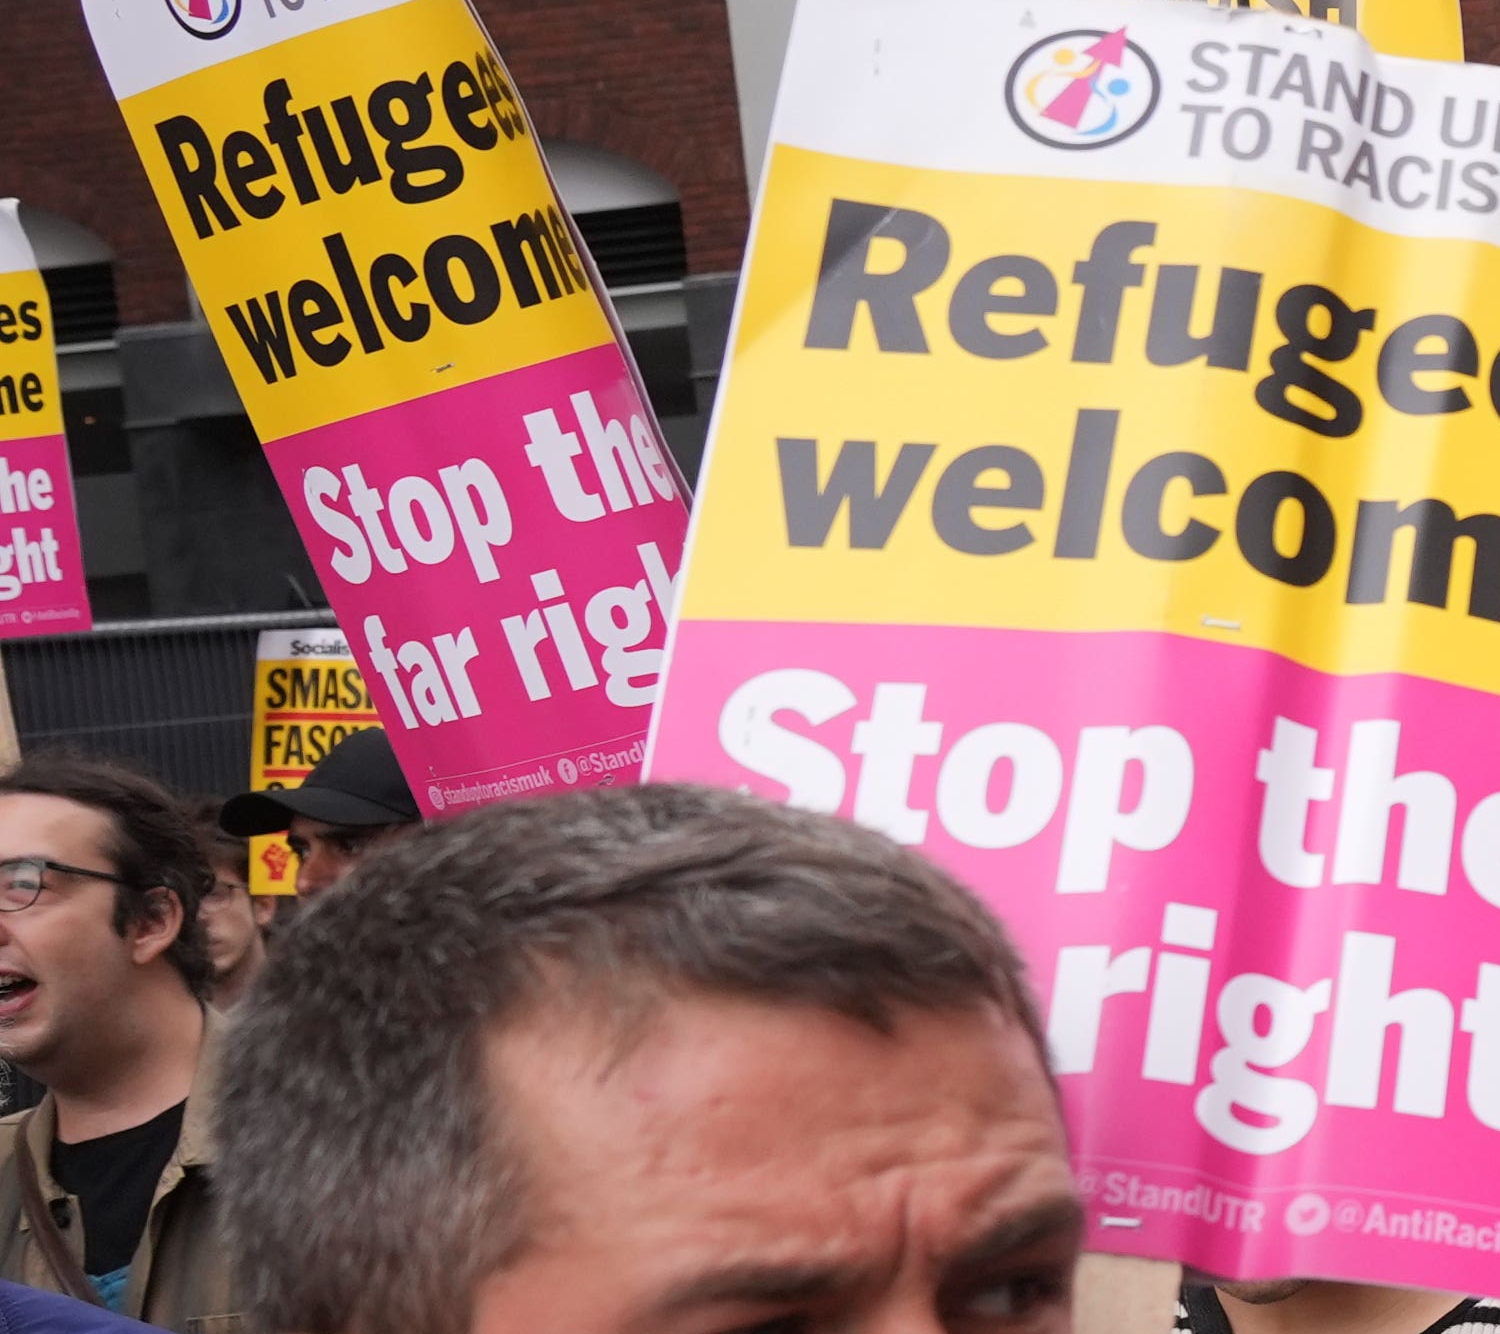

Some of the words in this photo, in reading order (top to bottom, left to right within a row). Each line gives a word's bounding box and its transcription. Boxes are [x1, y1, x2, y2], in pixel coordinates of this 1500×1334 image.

[155, 59, 522, 237] Refugees
[1181, 104, 1272, 164] TO
[1184, 37, 1414, 134] STAND
[227, 206, 588, 385] welcome
[302, 458, 513, 585] Stop
[525, 390, 675, 521] the
[367, 613, 480, 732] far
[444, 766, 554, 804] standuptoracismuk
[717, 667, 1193, 895] Stop
